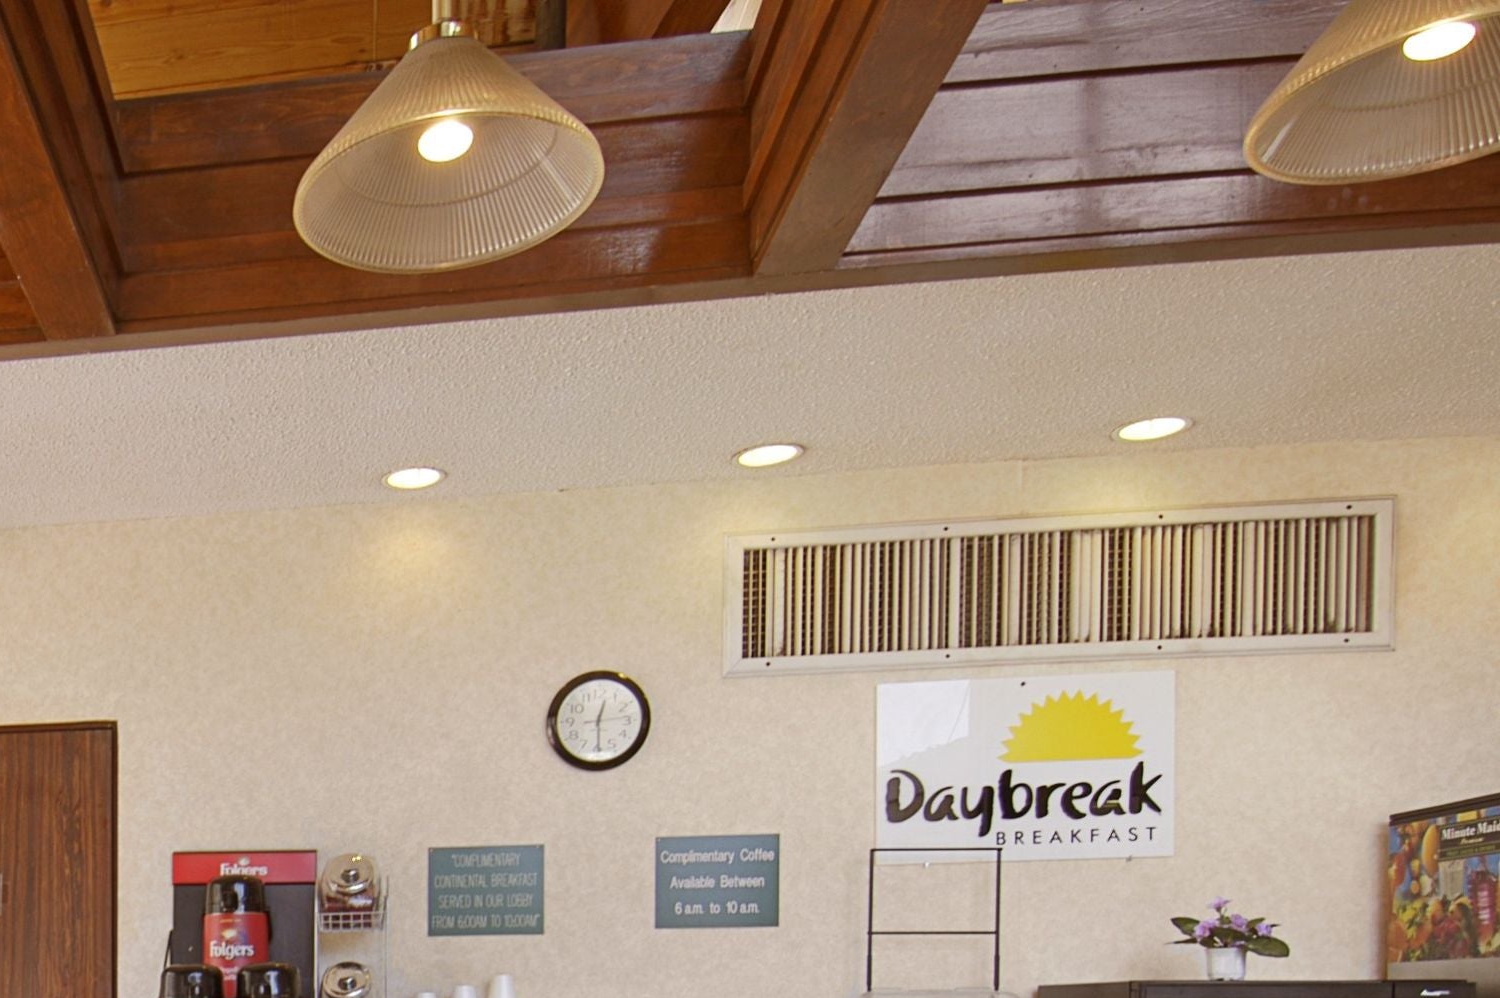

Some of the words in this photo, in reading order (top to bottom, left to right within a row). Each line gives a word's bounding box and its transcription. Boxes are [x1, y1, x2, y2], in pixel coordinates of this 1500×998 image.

[886, 761, 1163, 837] Daybreak
[995, 826, 1157, 846] BREAKFAST
[1441, 826, 1476, 840] Minute
[660, 850, 734, 865] Complimentary
[740, 848, 775, 861] Coffee
[434, 874, 488, 888] CONTINENTAL
[491, 872, 538, 887] BREAKFAST
[669, 876, 715, 889] Available
[720, 875, 765, 888] Between
[438, 894, 472, 909] SERVED
[473, 894, 484, 908] IN
[485, 893, 504, 908] OUR
[507, 893, 534, 908] LOBBY
[709, 902, 721, 914] to
[432, 914, 455, 929] FROM
[490, 914, 502, 928] TO
[209, 940, 255, 960] Folgers
